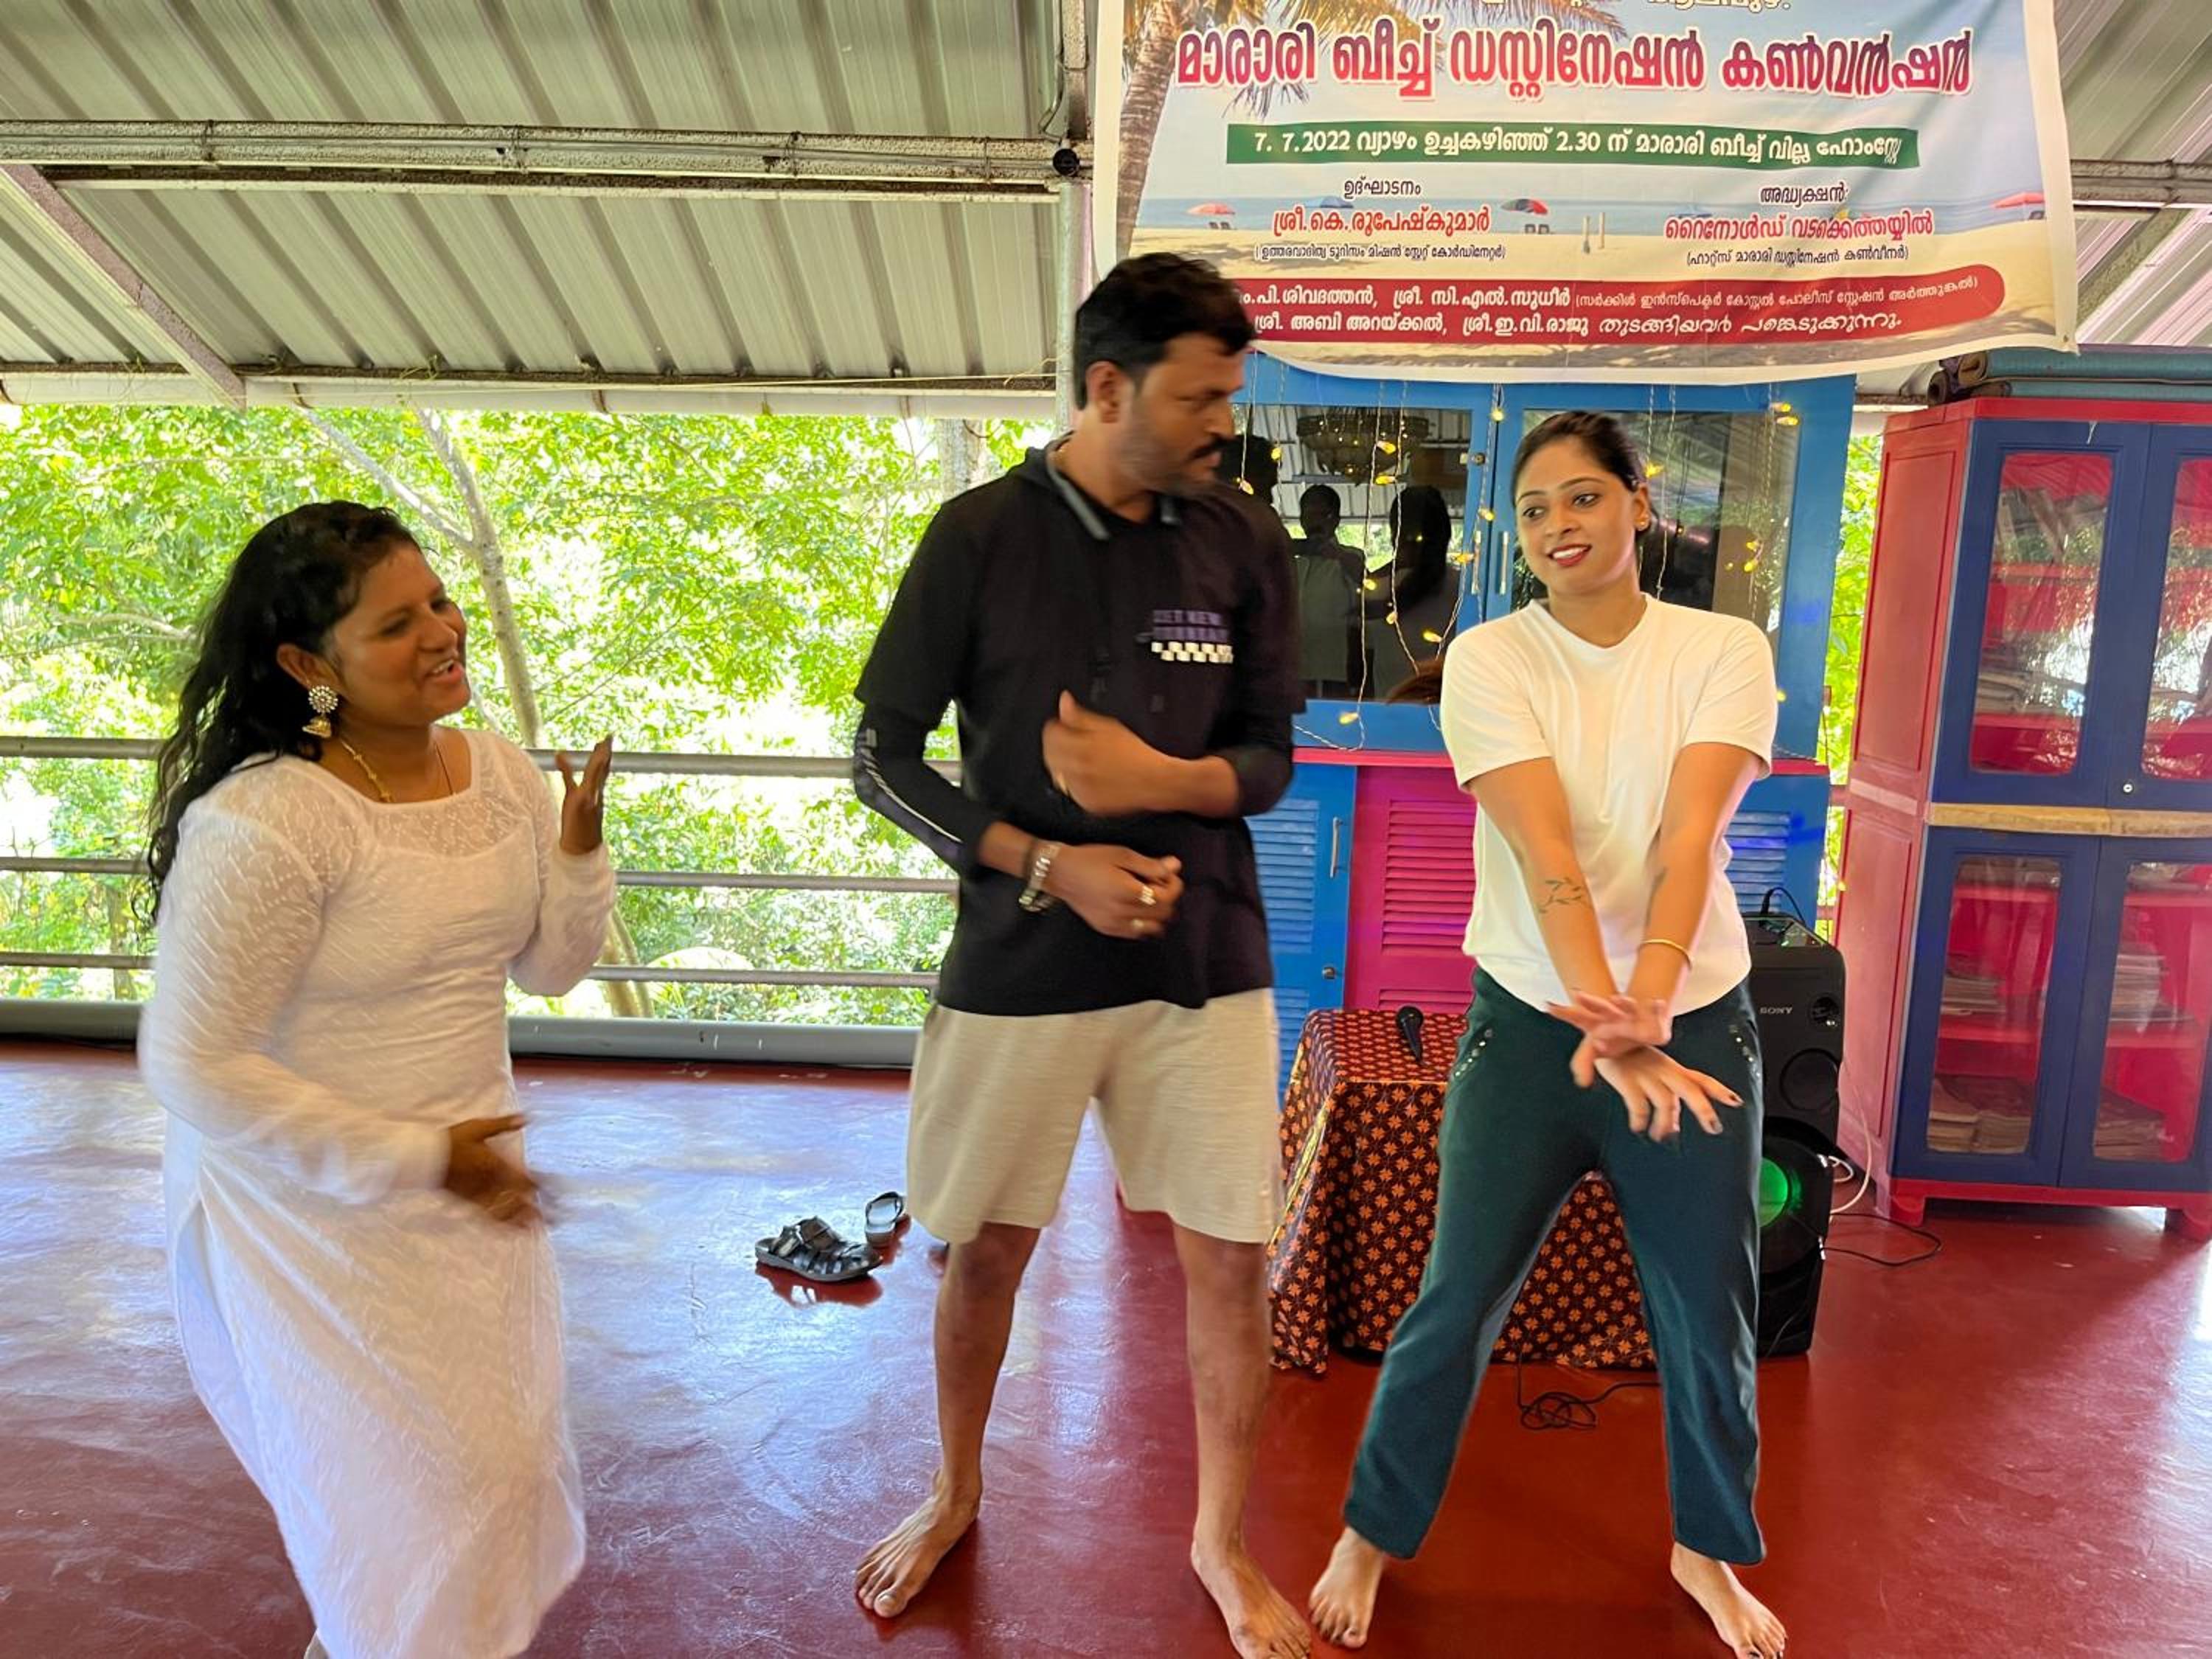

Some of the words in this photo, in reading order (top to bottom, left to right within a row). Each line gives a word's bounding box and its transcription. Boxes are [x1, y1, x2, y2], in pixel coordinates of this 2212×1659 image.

[1178, 21, 1315, 84] മാരാരി
[1332, 17, 1440, 97] ബീച്ച്
[1450, 19, 1703, 97] ഡസ്റ്റിനേഷൻ
[1722, 29, 1972, 97] കൺവൻഷൻ
[1357, 131, 1416, 156] വ്യാഴം
[1424, 126, 1554, 156] ഉച്ചകഴിഞ്ഞ്
[1556, 131, 1600, 152] 2.30
[1608, 128, 1632, 152] ന്
[1636, 130, 1704, 154] മാരാരി
[1710, 133, 1767, 164] ബീച്ച്
[1770, 136, 1811, 164] വില്ല
[1344, 176, 1422, 199] ഉദ്ഘാടനം
[1666, 214, 1787, 240] റൈനോൾഡ്
[1736, 247, 1773, 262] മാരാരി
[1778, 289, 1835, 306] പോലീസ്
[1291, 311, 1341, 331] അബി
[1599, 314, 1732, 337] തുടങ്ങിയവർ
